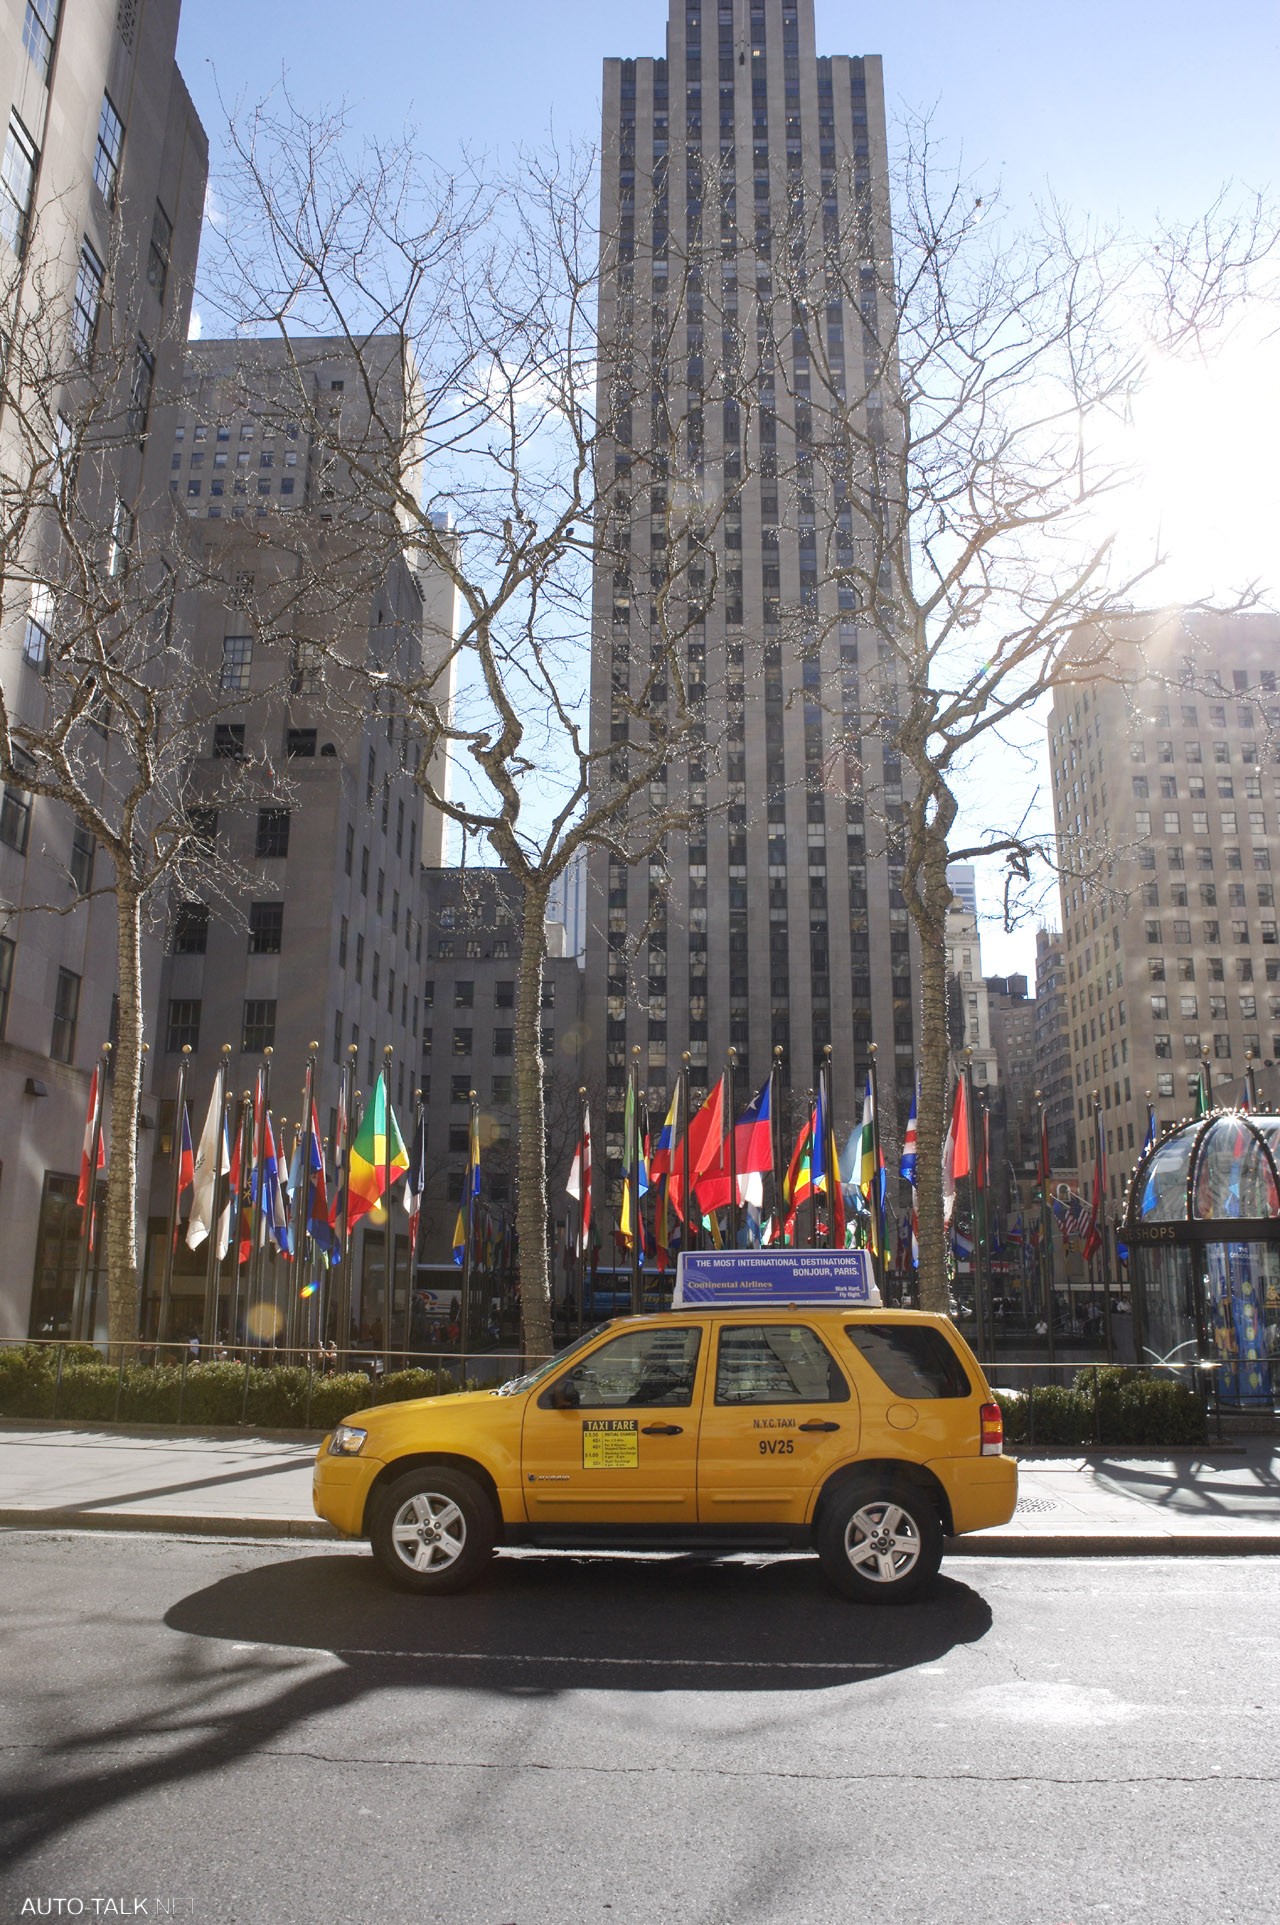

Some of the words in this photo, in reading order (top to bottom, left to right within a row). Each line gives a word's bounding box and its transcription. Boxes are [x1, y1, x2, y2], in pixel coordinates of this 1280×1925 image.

[1136, 1226, 1176, 1240] SHOPS
[696, 1259, 712, 1267] THE
[713, 1259, 736, 1267] MOST
[737, 1258, 799, 1267] INTERNATIONAL
[800, 1257, 859, 1266] DESTINATIONS.
[792, 1268, 833, 1277] BONJOUR,
[834, 1267, 860, 1276] PARIS.
[688, 1280, 738, 1289] Continental
[739, 1280, 773, 1288] Airlines
[587, 1421, 608, 1431] TAXI
[612, 1420, 635, 1430] FARE
[759, 1440, 794, 1455] 9V25
